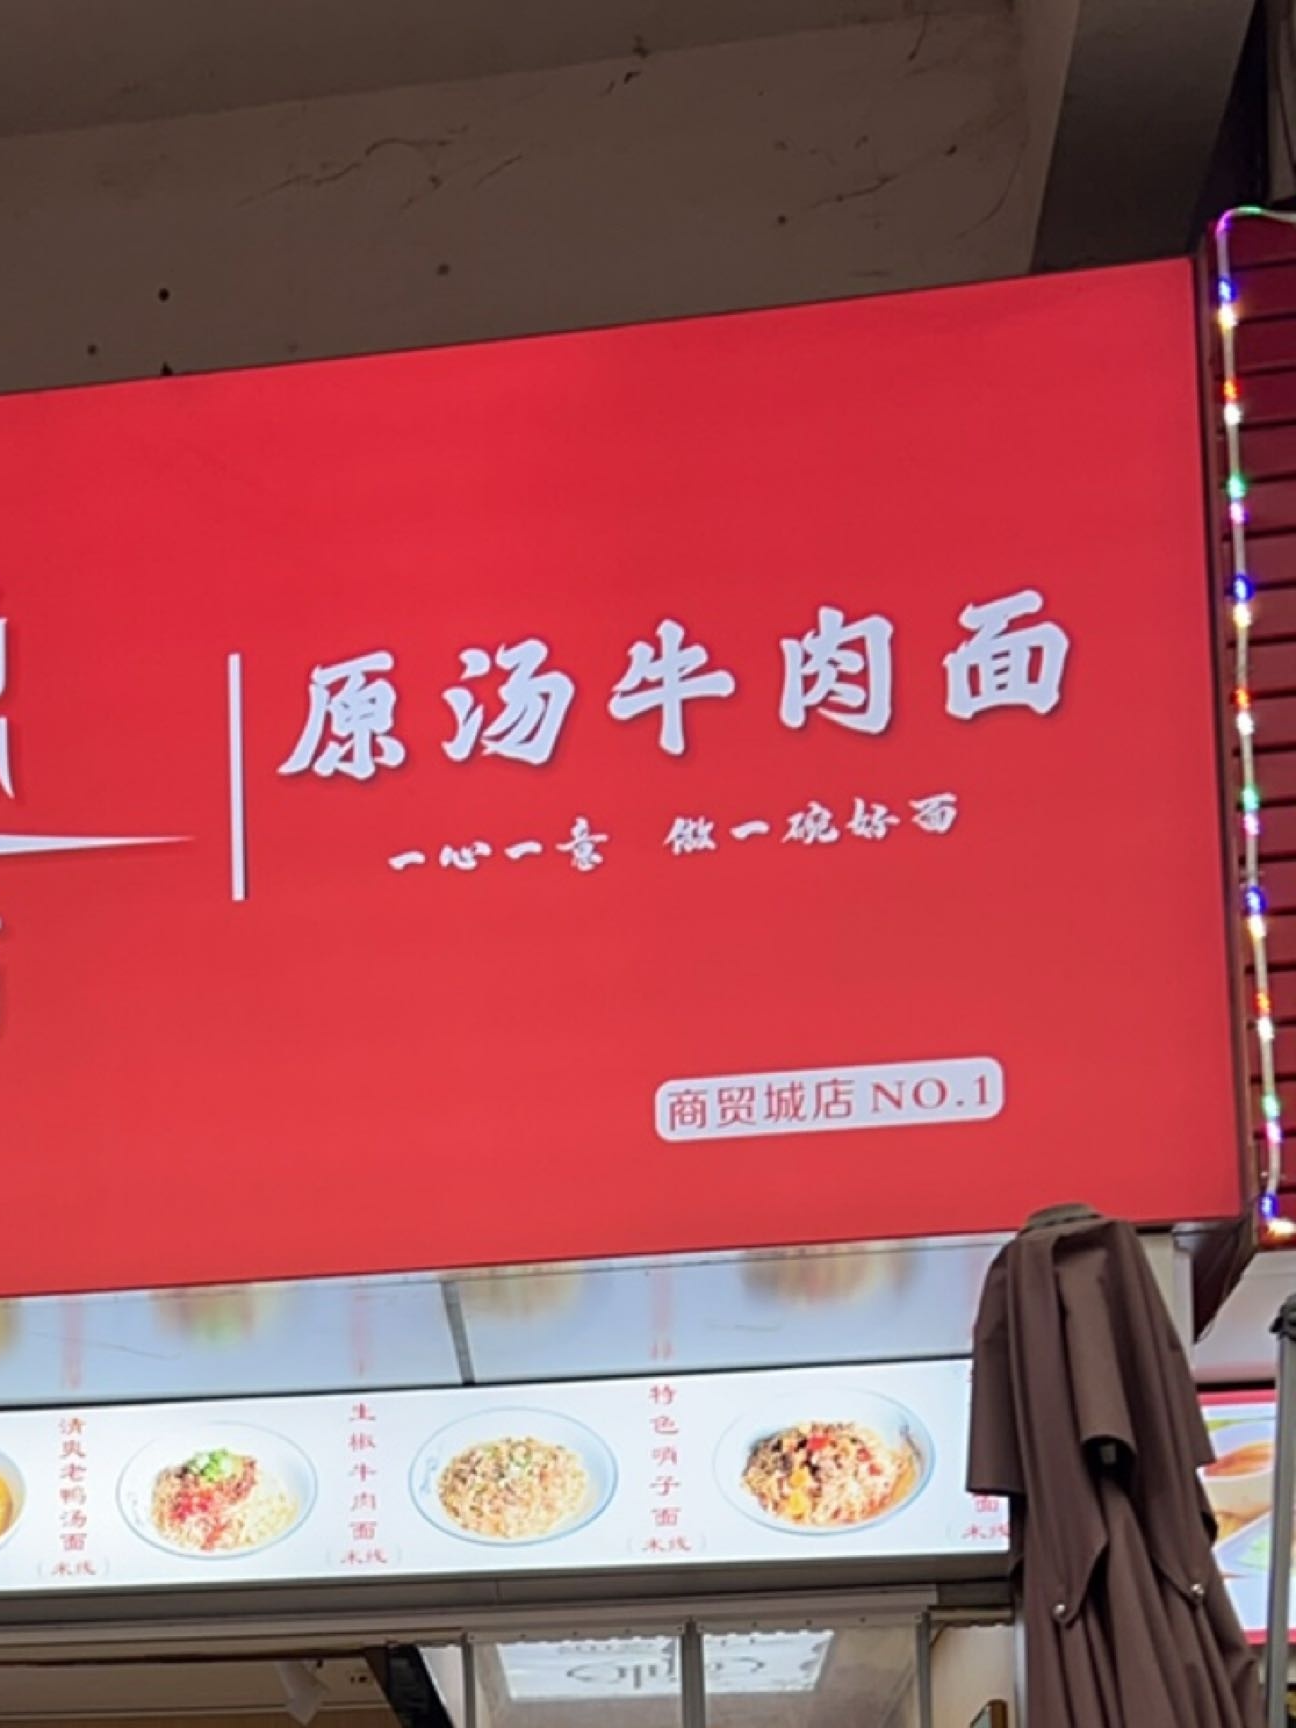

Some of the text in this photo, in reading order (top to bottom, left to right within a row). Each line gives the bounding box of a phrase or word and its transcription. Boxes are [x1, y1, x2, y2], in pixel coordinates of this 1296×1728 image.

[278, 589, 1071, 781] 原汤牛肉面
[388, 791, 959, 872] 一心一意 做一碗好面
[667, 1073, 990, 1132] 商贸城店 NO.1
